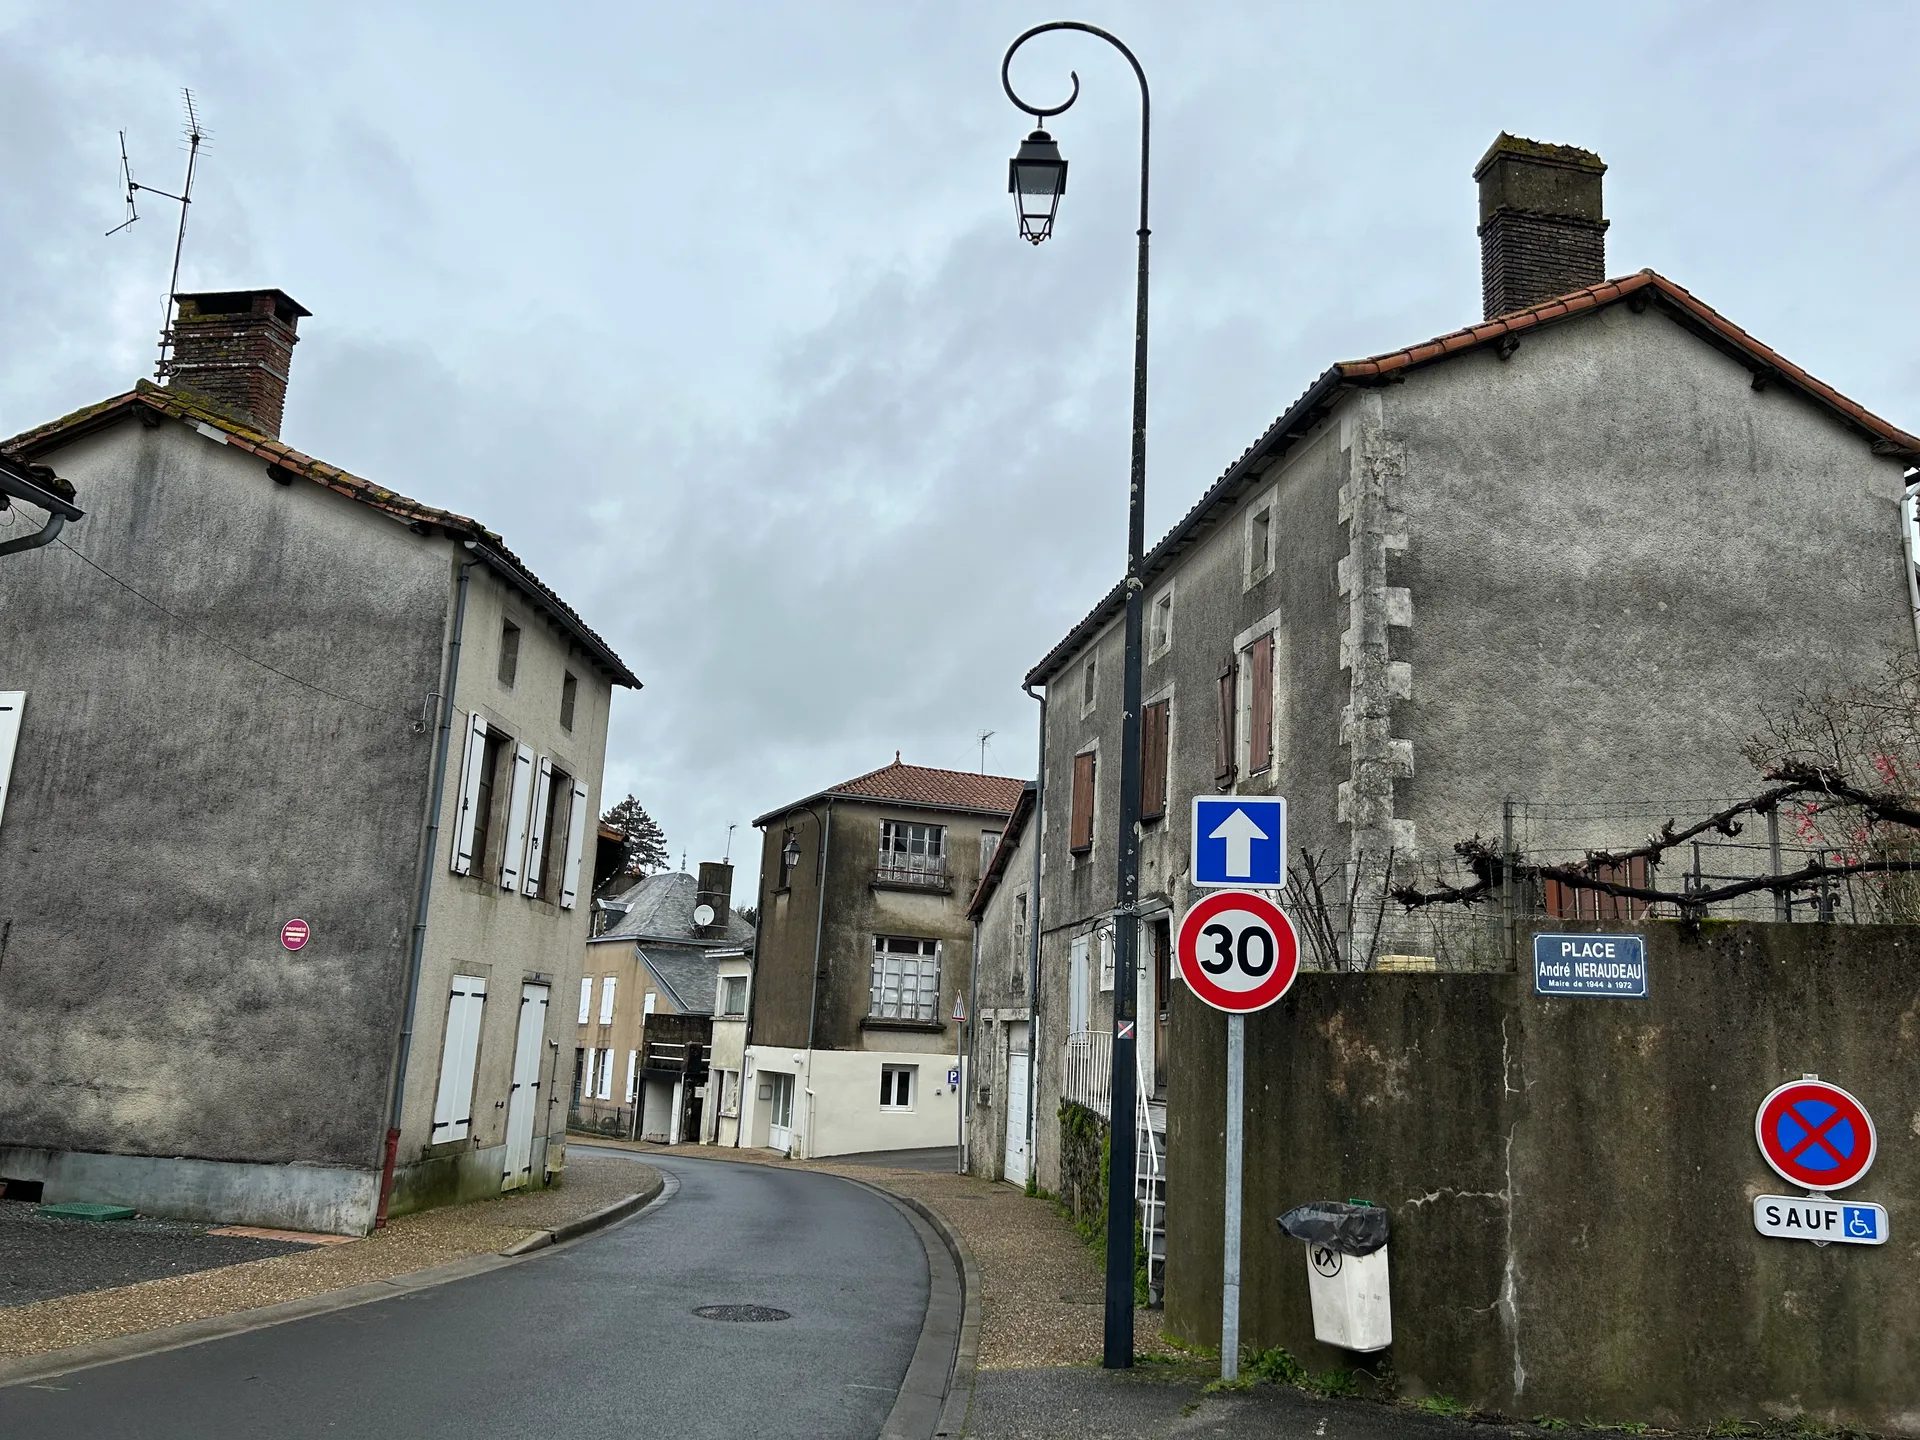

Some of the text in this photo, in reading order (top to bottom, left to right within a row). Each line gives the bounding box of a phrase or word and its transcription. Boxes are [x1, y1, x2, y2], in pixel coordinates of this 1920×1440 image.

[1200, 923, 1274, 977] 30
[1561, 942, 1616, 958] PLACE
[1539, 961, 1641, 979] André NERAUDEAU
[1548, 979, 1633, 989] Maire de 1944 à 1972
[950, 1071, 957, 1080] P
[1765, 1205, 1838, 1230] SAUF
